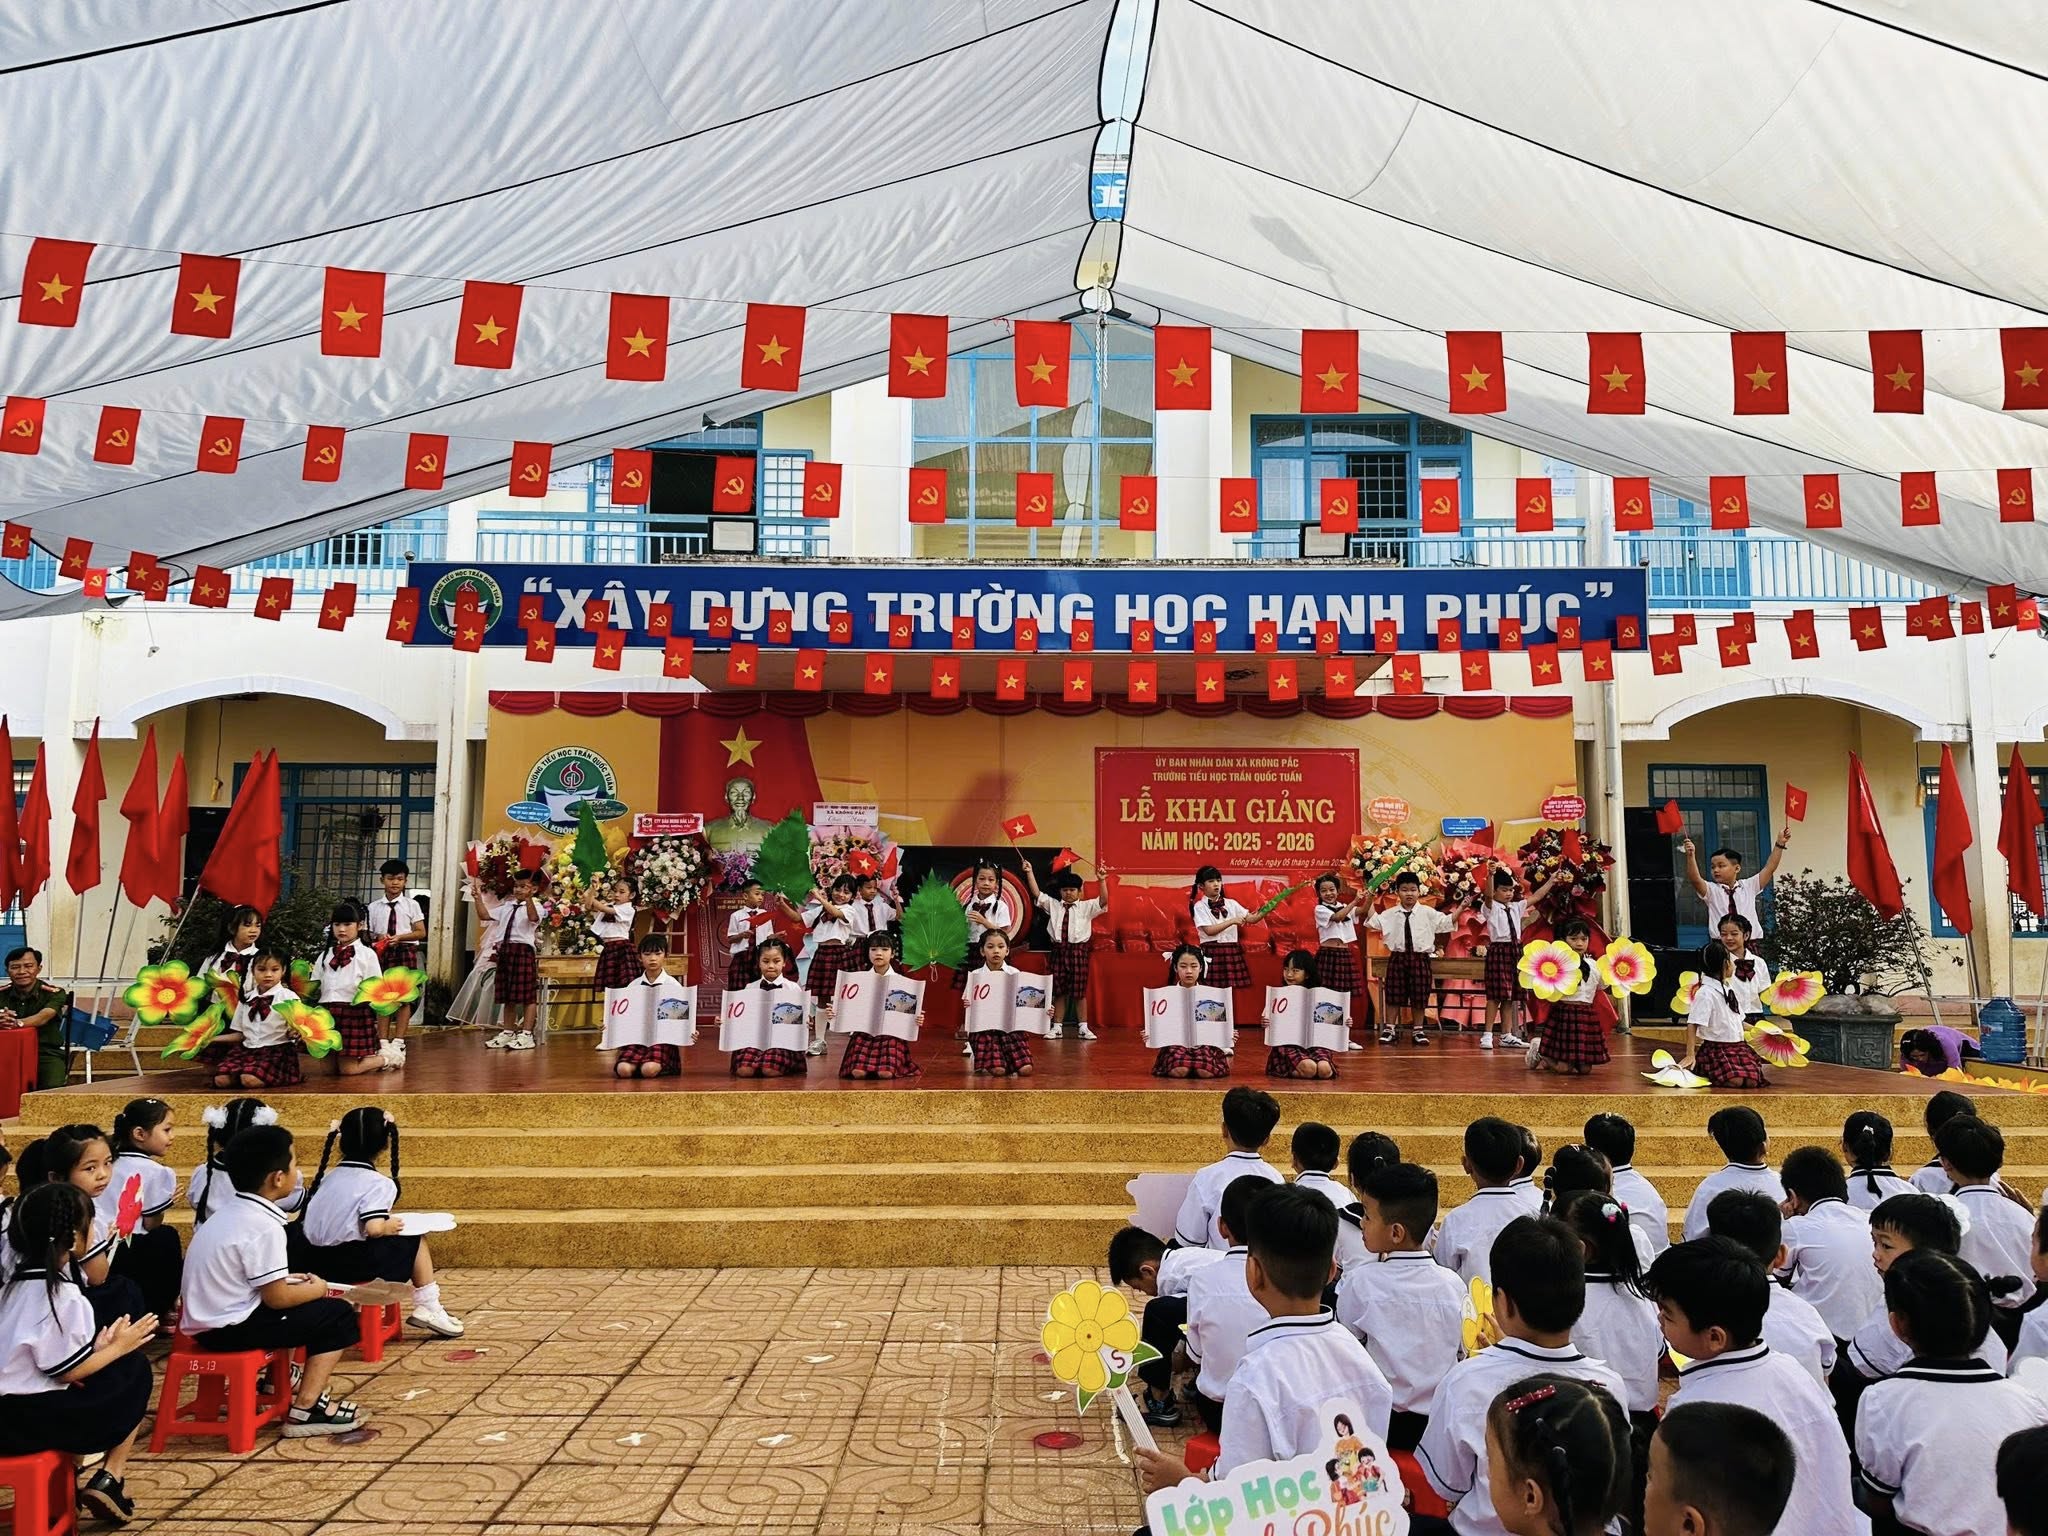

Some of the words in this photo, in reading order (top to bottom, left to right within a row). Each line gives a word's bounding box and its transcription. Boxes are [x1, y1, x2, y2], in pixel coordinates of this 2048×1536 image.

[690, 587, 848, 641] DỰNG
[867, 583, 1094, 634] TRƯỜNG
[1115, 594, 1227, 643] HỌC
[1249, 594, 1405, 643] HẠNH
[1168, 758, 1187, 768] BAN
[1189, 756, 1213, 768] NHÂN
[1216, 756, 1234, 768] DÂN
[1235, 756, 1248, 768] XÃ
[1249, 756, 1280, 768] KRÔNG
[1152, 770, 1187, 782] TRƯỜNG
[1188, 769, 1208, 782] TIỂU
[1209, 772, 1227, 784] HỌC
[1229, 769, 1252, 782] TRẦN
[1253, 769, 1278, 783] QUỐC
[1279, 769, 1303, 782] TUẤN
[1119, 785, 1156, 822] LỄ
[1165, 798, 1237, 823] KHAI
[1245, 789, 1336, 824] GIẢNG
[550, 824, 577, 835] KRÔN
[1141, 828, 1178, 851] NĂM
[1183, 831, 1219, 855] HỌC:
[1223, 832, 1262, 851] 2025
[1276, 832, 1315, 851] 2026
[840, 983, 859, 1000] 10
[972, 983, 991, 1001] 10
[611, 998, 630, 1016] 10
[727, 1001, 746, 1018] 10
[1151, 999, 1168, 1016] 10
[1271, 997, 1288, 1014] 10
[1240, 1470, 1322, 1518] Học
